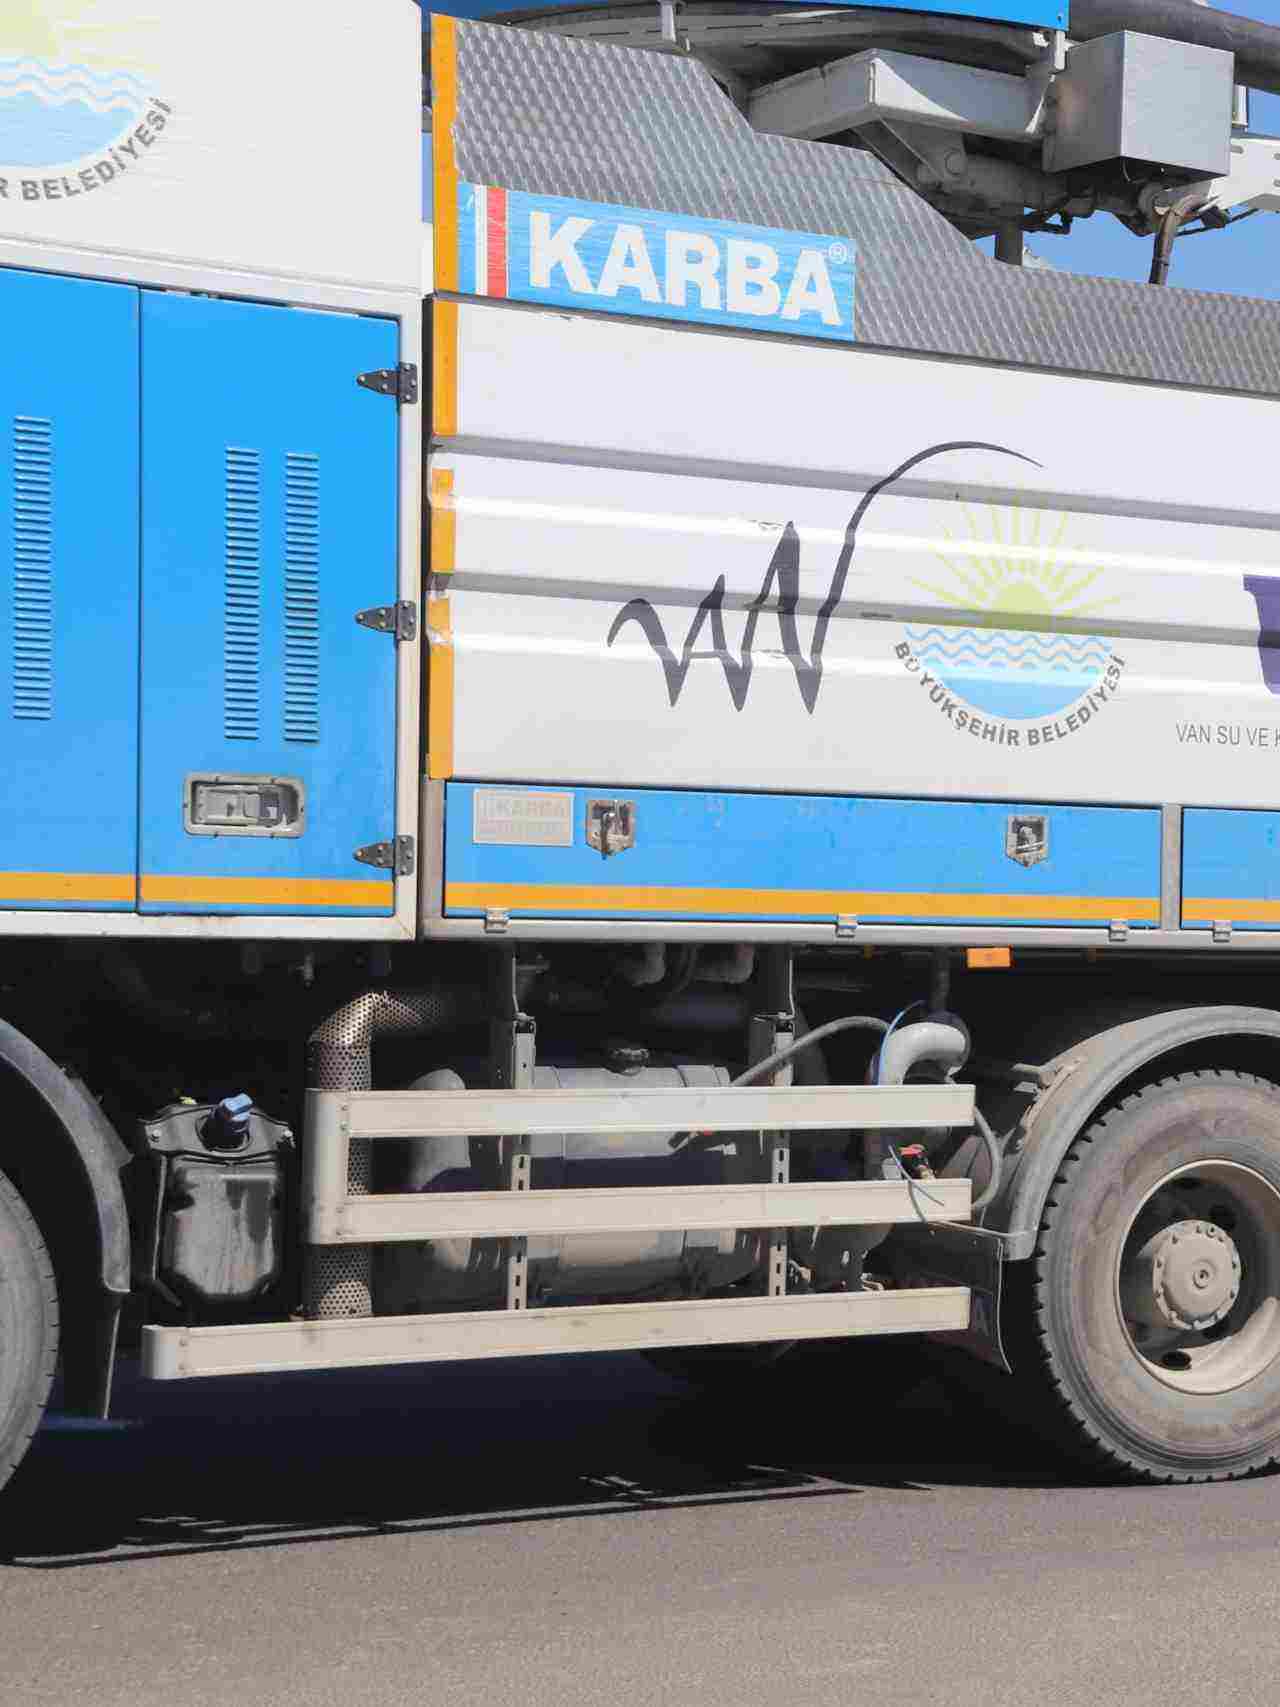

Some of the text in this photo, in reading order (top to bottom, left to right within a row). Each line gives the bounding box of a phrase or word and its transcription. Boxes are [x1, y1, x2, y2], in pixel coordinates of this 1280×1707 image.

[21, 97, 172, 200] BELEDİYESİ
[894, 641, 1126, 746] BÜYÜKŞEHİR BELEDİYESİ
[1176, 723, 1211, 744] VAN
[1216, 725, 1240, 746] SU
[1246, 727, 1269, 747] VE
